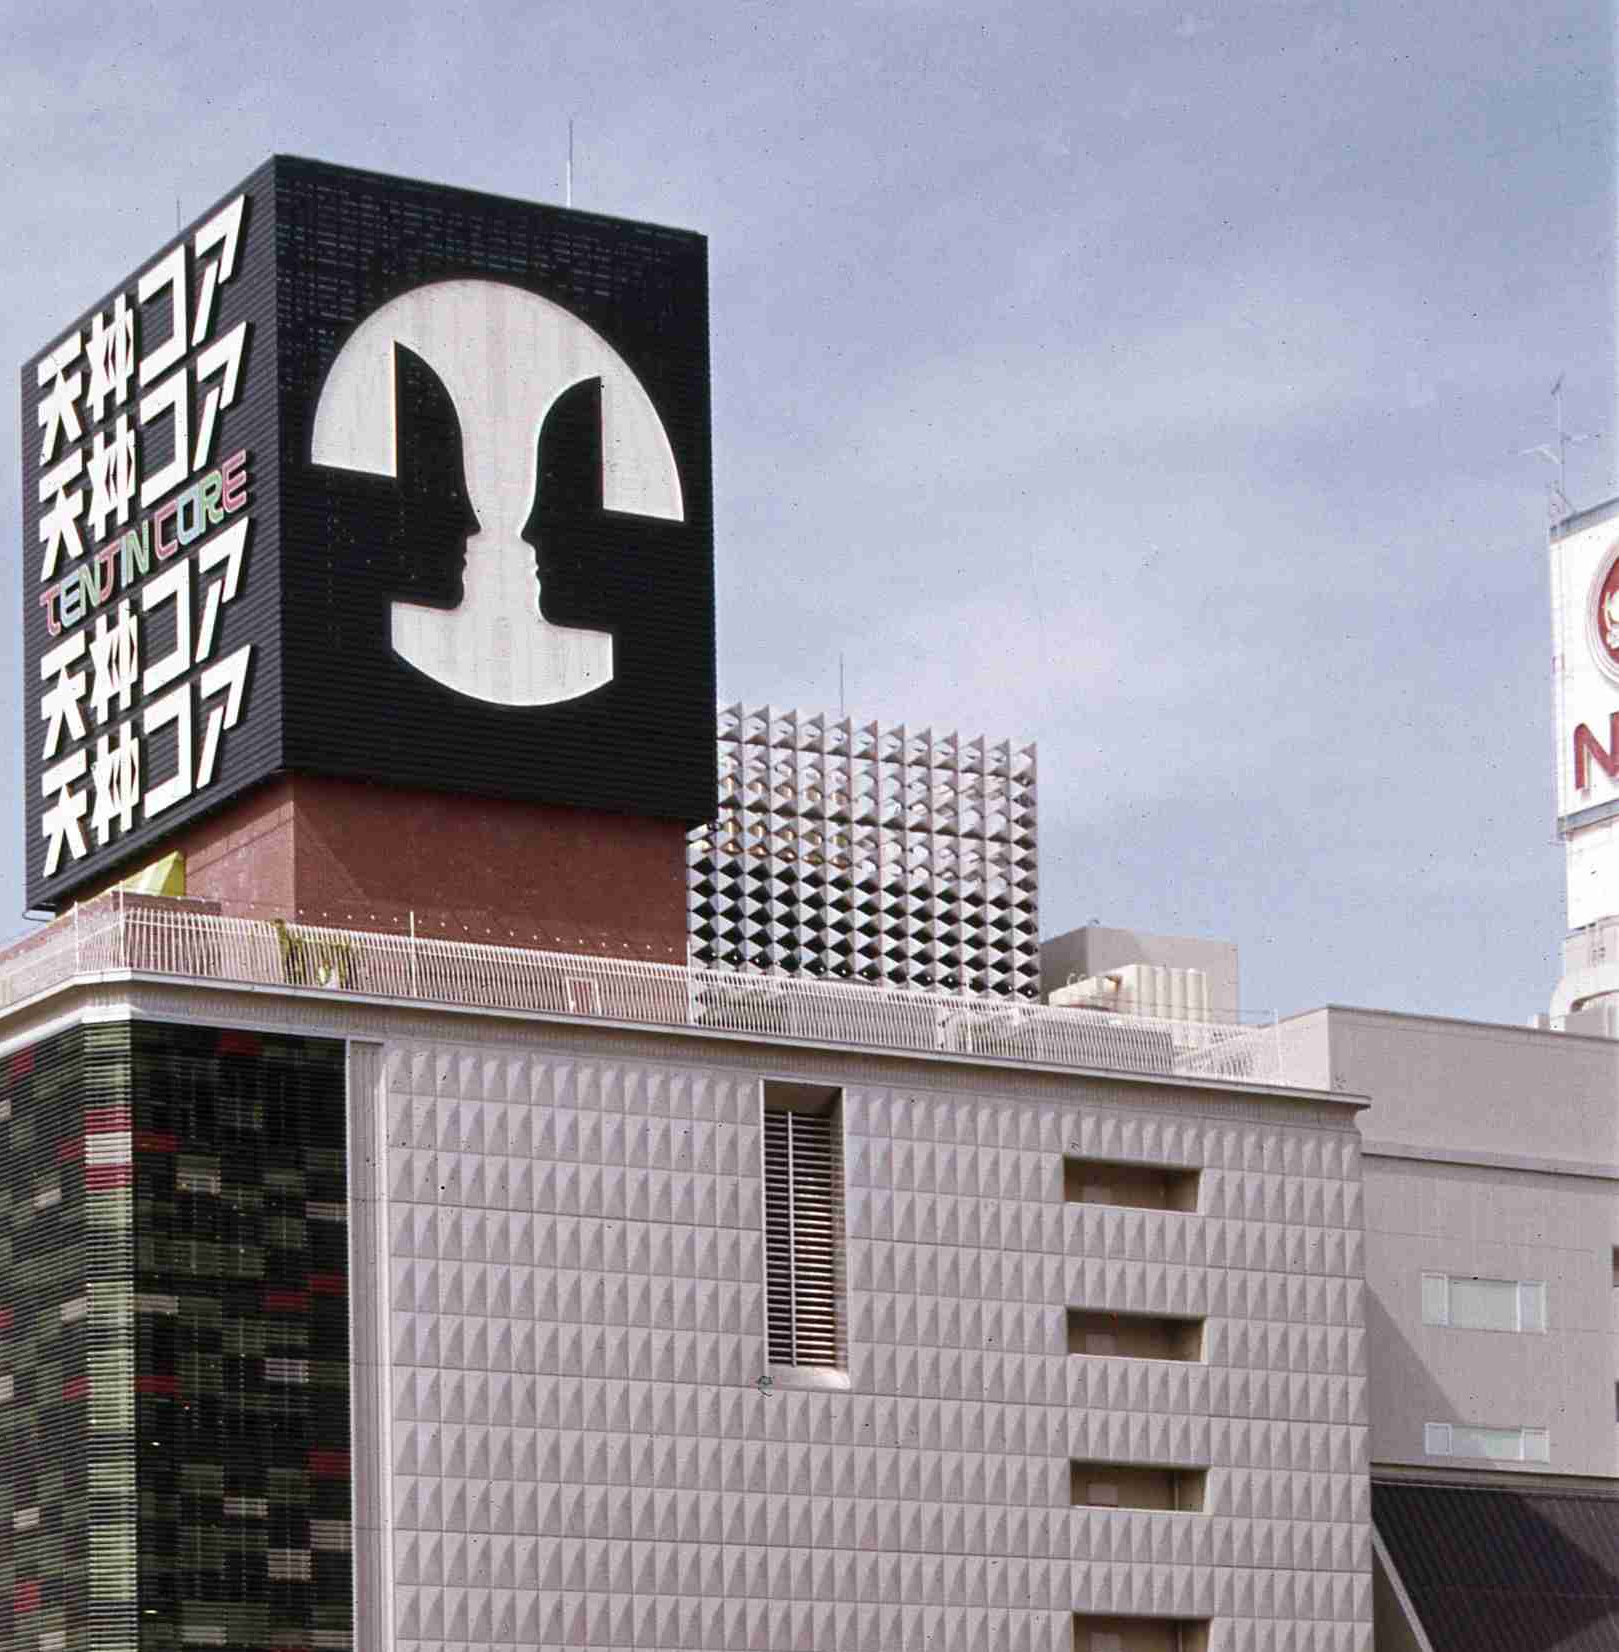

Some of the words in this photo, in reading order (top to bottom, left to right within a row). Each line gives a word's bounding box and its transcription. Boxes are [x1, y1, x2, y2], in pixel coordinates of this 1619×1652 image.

[37, 194, 245, 465] 天神コア
[38, 321, 248, 583] 天神コア
[39, 530, 153, 637] TENJIN
[153, 449, 248, 562] CORE
[40, 517, 249, 760] 天神コア
[42, 643, 252, 878] 天神コア
